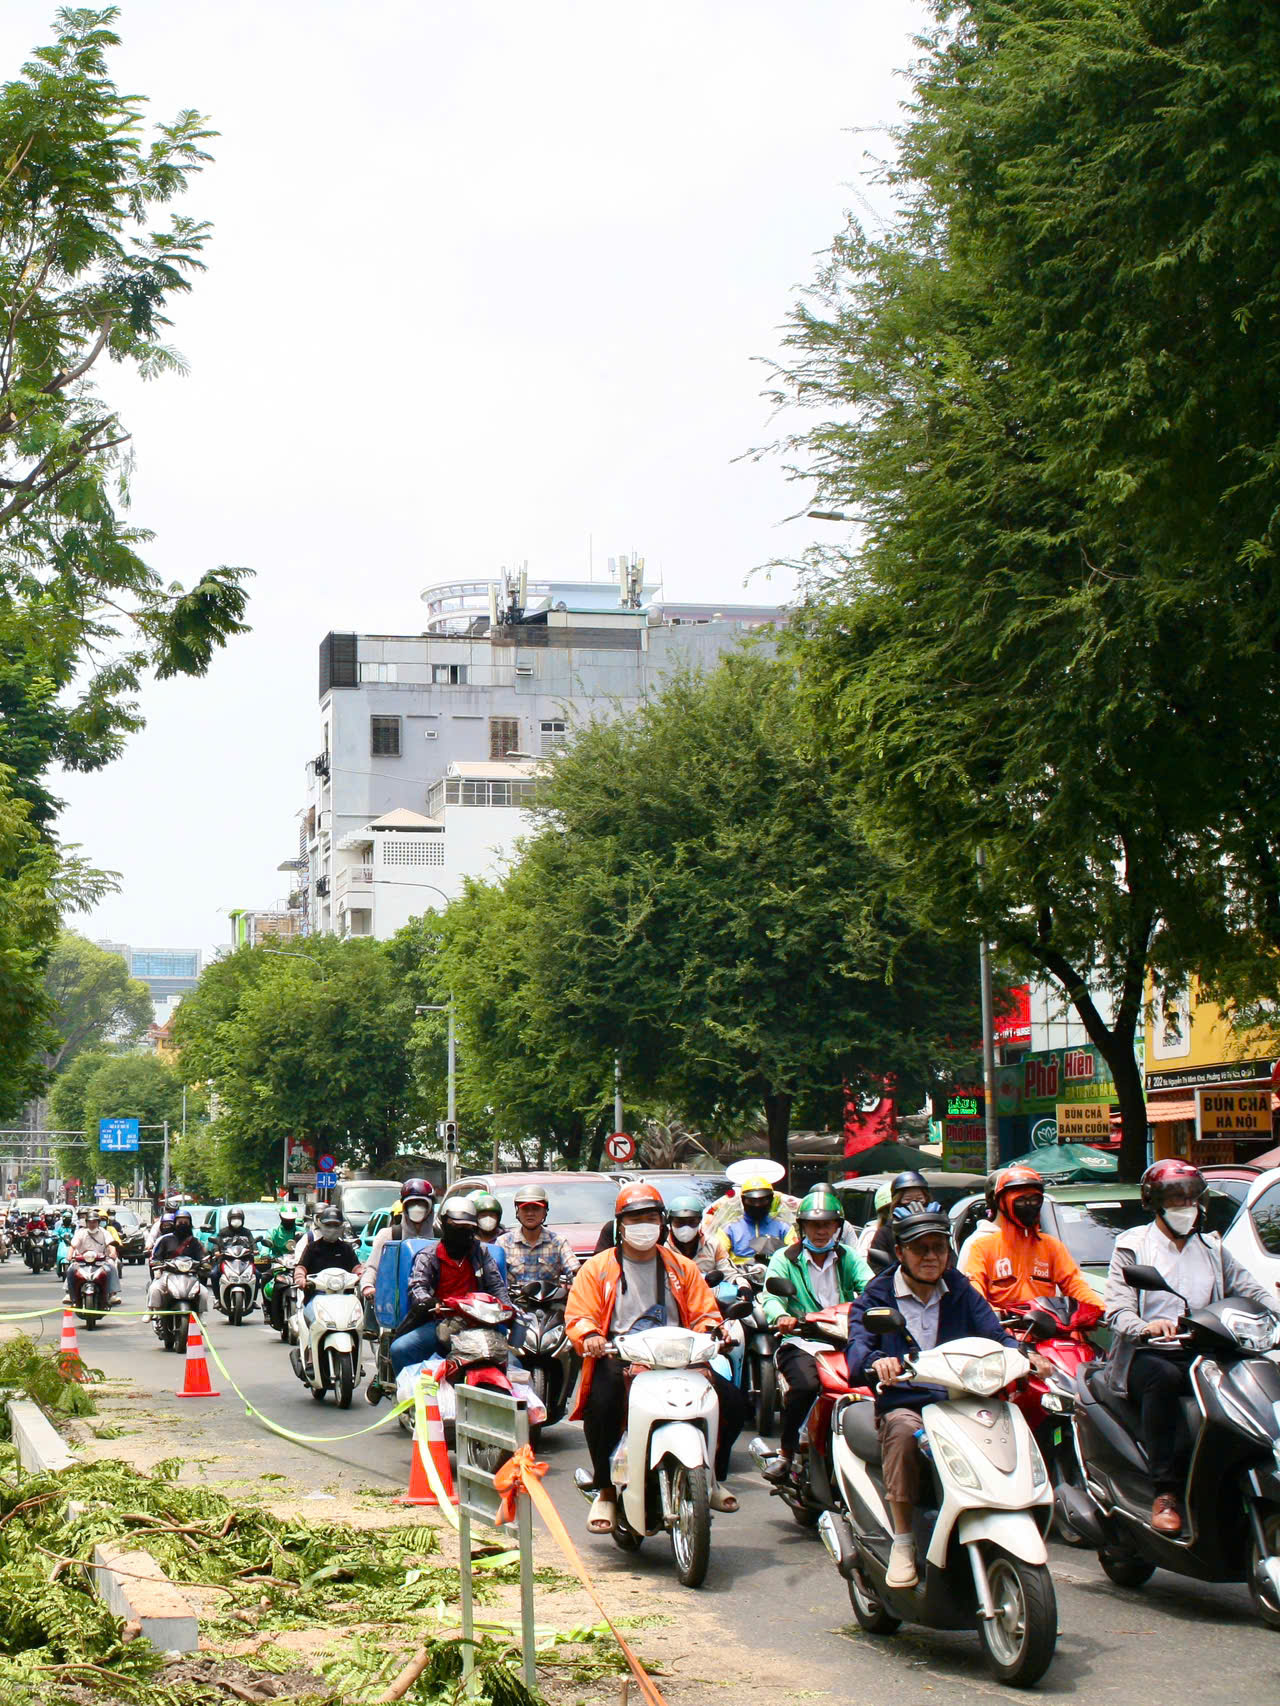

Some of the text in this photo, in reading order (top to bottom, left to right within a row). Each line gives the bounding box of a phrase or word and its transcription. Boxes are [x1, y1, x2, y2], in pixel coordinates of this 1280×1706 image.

[1024, 1049, 1094, 1099] Phở Hiền
[1153, 1076, 1163, 1087] 202
[1204, 1093, 1268, 1111] BÚN CHẢ
[1065, 1106, 1102, 1119] BÚN CHẢ
[1059, 1121, 1083, 1134] BÁNH
[1216, 1114, 1257, 1129] HÀ NỘI
